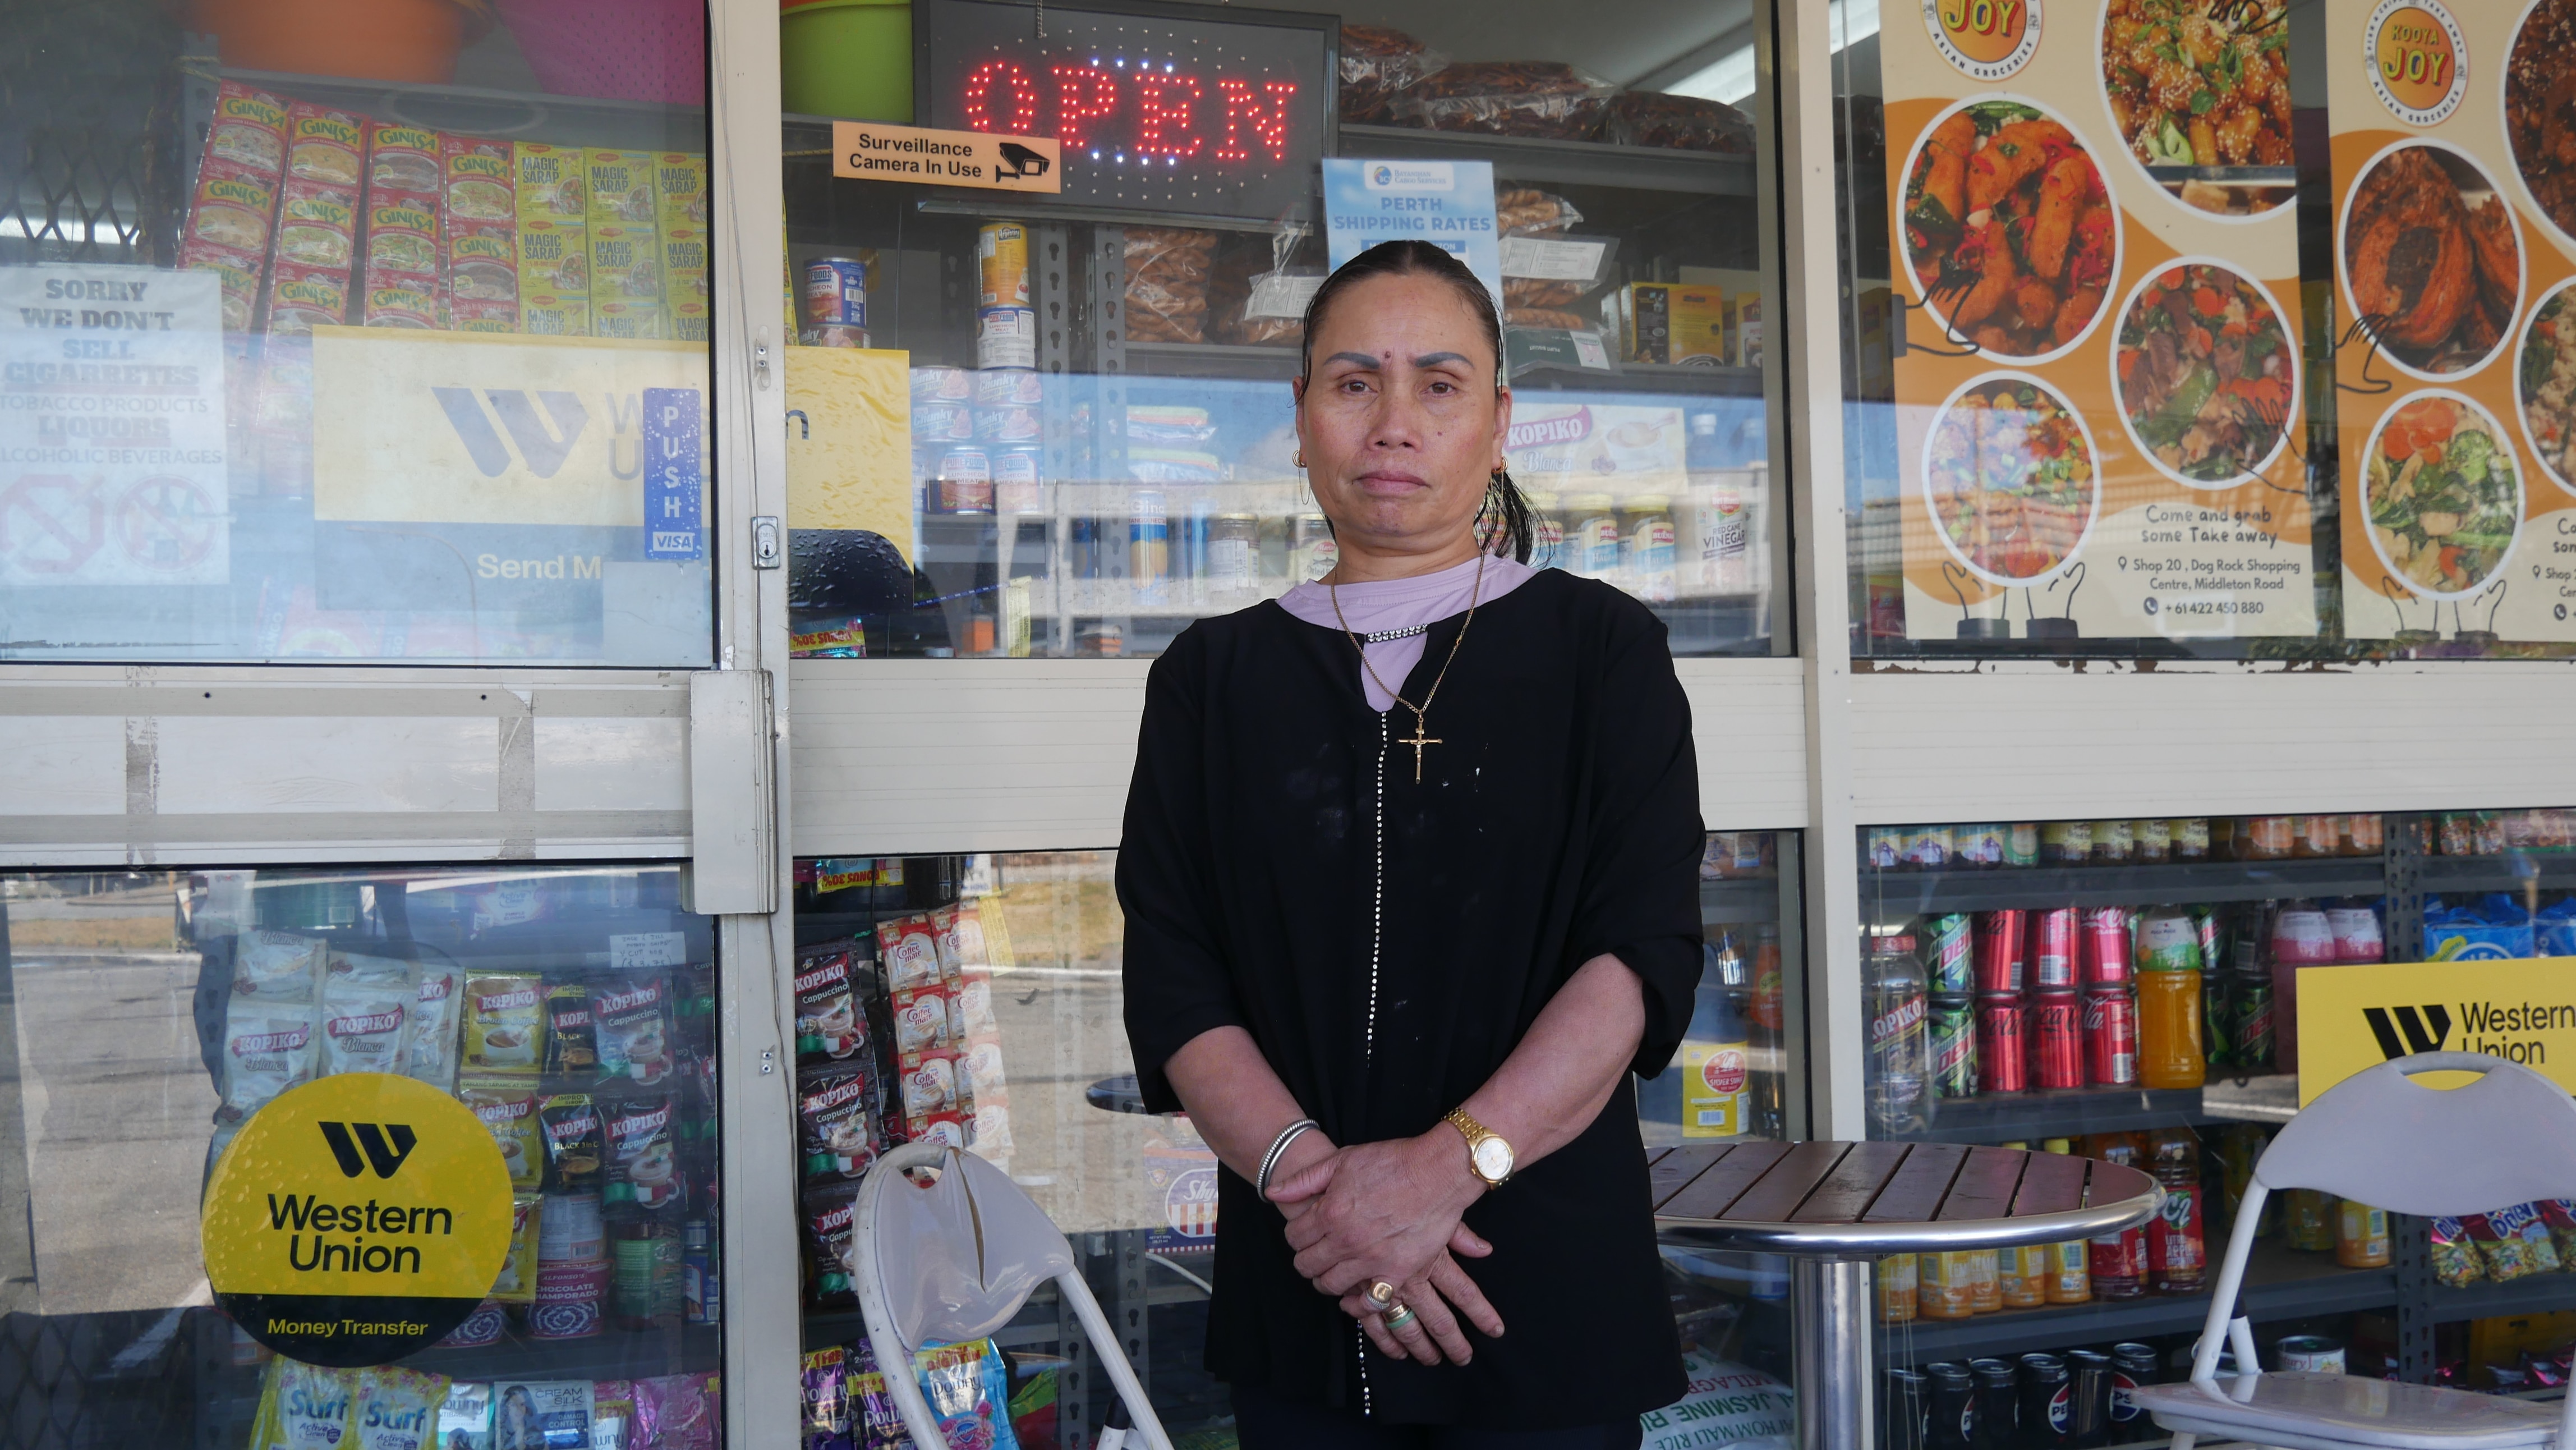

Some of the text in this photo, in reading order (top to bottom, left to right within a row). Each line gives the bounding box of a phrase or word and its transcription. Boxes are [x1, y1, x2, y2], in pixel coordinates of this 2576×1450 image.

[1944, 0, 2020, 37] JOY
[2392, 25, 2439, 45] KOOYA
[1933, 33, 2032, 77] ASIAN GROCERIES
[2383, 47, 2450, 86] JOY
[226, 99, 285, 128] GINISA
[966, 61, 1296, 161] OPEN
[301, 120, 358, 144] GINISA
[378, 130, 436, 150] GINISA
[859, 133, 973, 158] Surveillance
[453, 156, 508, 177] GINISA
[522, 157, 559, 171] MAGIC
[849, 153, 982, 178] Camera In Use
[523, 170, 559, 184] SARAP
[591, 167, 628, 180] MAGIC
[660, 168, 696, 182] MAGIC
[592, 180, 629, 193] SARAP
[661, 181, 697, 195] SARAP
[1381, 197, 1442, 211] PERTH
[376, 209, 433, 231] GINISA
[1335, 215, 1491, 231] SHIPPING RATES
[456, 238, 510, 259] GINISA
[524, 234, 561, 247] MAGIC
[595, 241, 632, 255] MAGIC
[668, 243, 702, 256] MAGIC
[525, 247, 562, 260] SARAP
[596, 254, 632, 268] SARAP
[669, 256, 703, 269] SARAP
[45, 279, 148, 301] SORRY
[373, 290, 430, 313] GINISA
[20, 308, 174, 331] WE DON'T
[527, 310, 565, 323] MAGIC
[598, 317, 634, 331] MAGIC
[62, 339, 135, 360] SELL
[4, 362, 199, 385] CIGARRETES
[979, 374, 1016, 391] Chunky
[102, 397, 208, 413] PRODUCTS
[913, 409, 953, 424] Chunky
[38, 416, 171, 438] LIQUORS
[1508, 419, 1583, 447] KOPIKO
[0, 449, 222, 464] LCOHOLIC BEVERAGES
[664, 405, 683, 518] PUSH
[1522, 451, 1572, 472] Blanca
[1130, 497, 1165, 515] Gina
[2146, 504, 2272, 527] Come and grab
[1727, 523, 1742, 533] CANE
[656, 535, 694, 549] VISA
[1703, 533, 1745, 549] VINEGAR
[2142, 526, 2278, 549] some Take away
[477, 554, 564, 580] Send
[2133, 559, 2301, 575] Shop 20 Dog Rock Shopping
[2546, 568, 2572, 581] Shop
[2150, 577, 2284, 591] Centre, Middleton Road
[2190, 602, 2213, 614] 422
[2216, 602, 2238, 614] 450
[2241, 602, 2264, 614] 880
[793, 628, 853, 647] BONUS 30%
[822, 873, 845, 885] 30%
[946, 932, 969, 948] Coffee
[896, 945, 920, 960] Coffee
[904, 949, 922, 963] mate
[794, 963, 846, 990] KOPIKO
[482, 991, 535, 1011] KOPIKO
[601, 988, 656, 1014] KOPIKO
[802, 981, 850, 1005] Cappuccino
[957, 994, 979, 1010] Coffee
[509, 1015, 539, 1026] Coffee
[608, 1008, 658, 1027] Cappuccino
[906, 1007, 932, 1023] Coffee
[914, 1013, 932, 1026] mate
[2460, 1002, 2576, 1034] Western
[334, 1014, 395, 1035] KOPIKO
[238, 1032, 301, 1054] KOPIKO
[342, 1036, 385, 1053] Blanca
[913, 1071, 939, 1086] Coffee
[921, 1077, 940, 1090] mate
[1709, 1077, 1731, 1087] SILVER
[807, 1084, 860, 1109] KOPIKO
[816, 1100, 862, 1124] Cappuccino
[611, 1111, 666, 1137] KOPIKO
[969, 1118, 995, 1133] Coffee
[554, 1142, 579, 1150] BLACK
[617, 1131, 667, 1150] Cappuccino
[267, 1193, 452, 1235] Western
[2163, 1195, 2192, 1226] C2
[289, 1235, 421, 1273] Union
[541, 1272, 585, 1281] ALFONSO'S
[267, 1319, 429, 1337] Money Transfer
[927, 1350, 981, 1371] BIGATIN
[535, 1387, 583, 1399] CREAM
[934, 1376, 981, 1396] Downy
[289, 1389, 350, 1421] Surf
[936, 1393, 964, 1402] ANTIBAC
[1670, 1393, 1770, 1422] JASMINE
[365, 1402, 426, 1433] Surf
[548, 1420, 586, 1429] CONTROL
[1654, 1420, 1776, 1450] HOM MALI RICE
